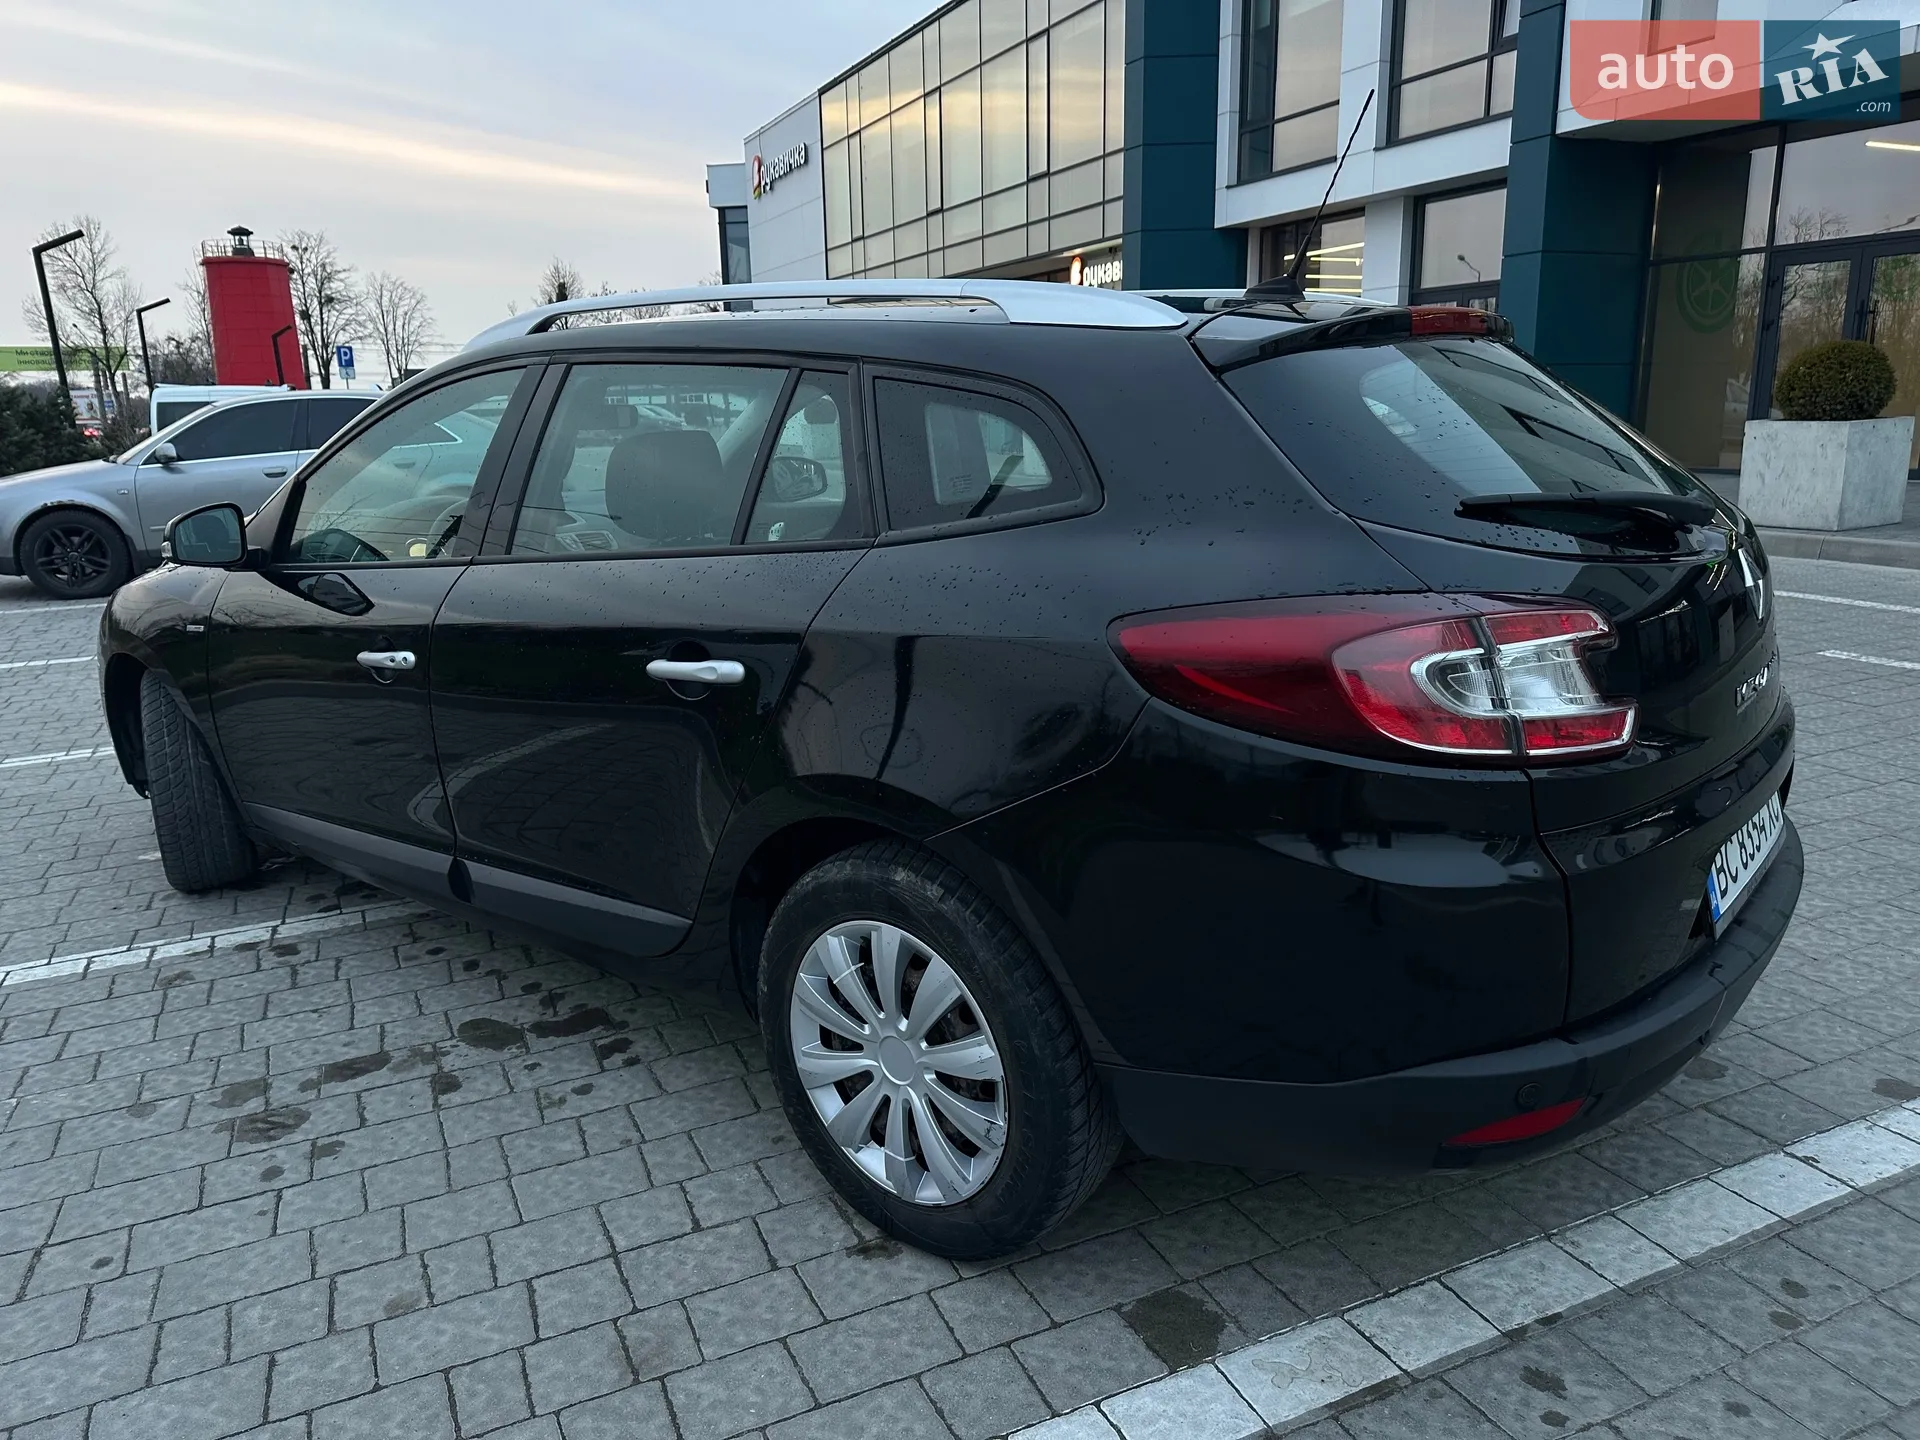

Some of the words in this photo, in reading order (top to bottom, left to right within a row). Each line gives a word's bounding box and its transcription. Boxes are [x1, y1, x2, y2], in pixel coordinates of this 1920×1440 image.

[760, 142, 807, 195] рукавичка
[340, 348, 351, 366] P
[1714, 838, 1738, 900] BC
